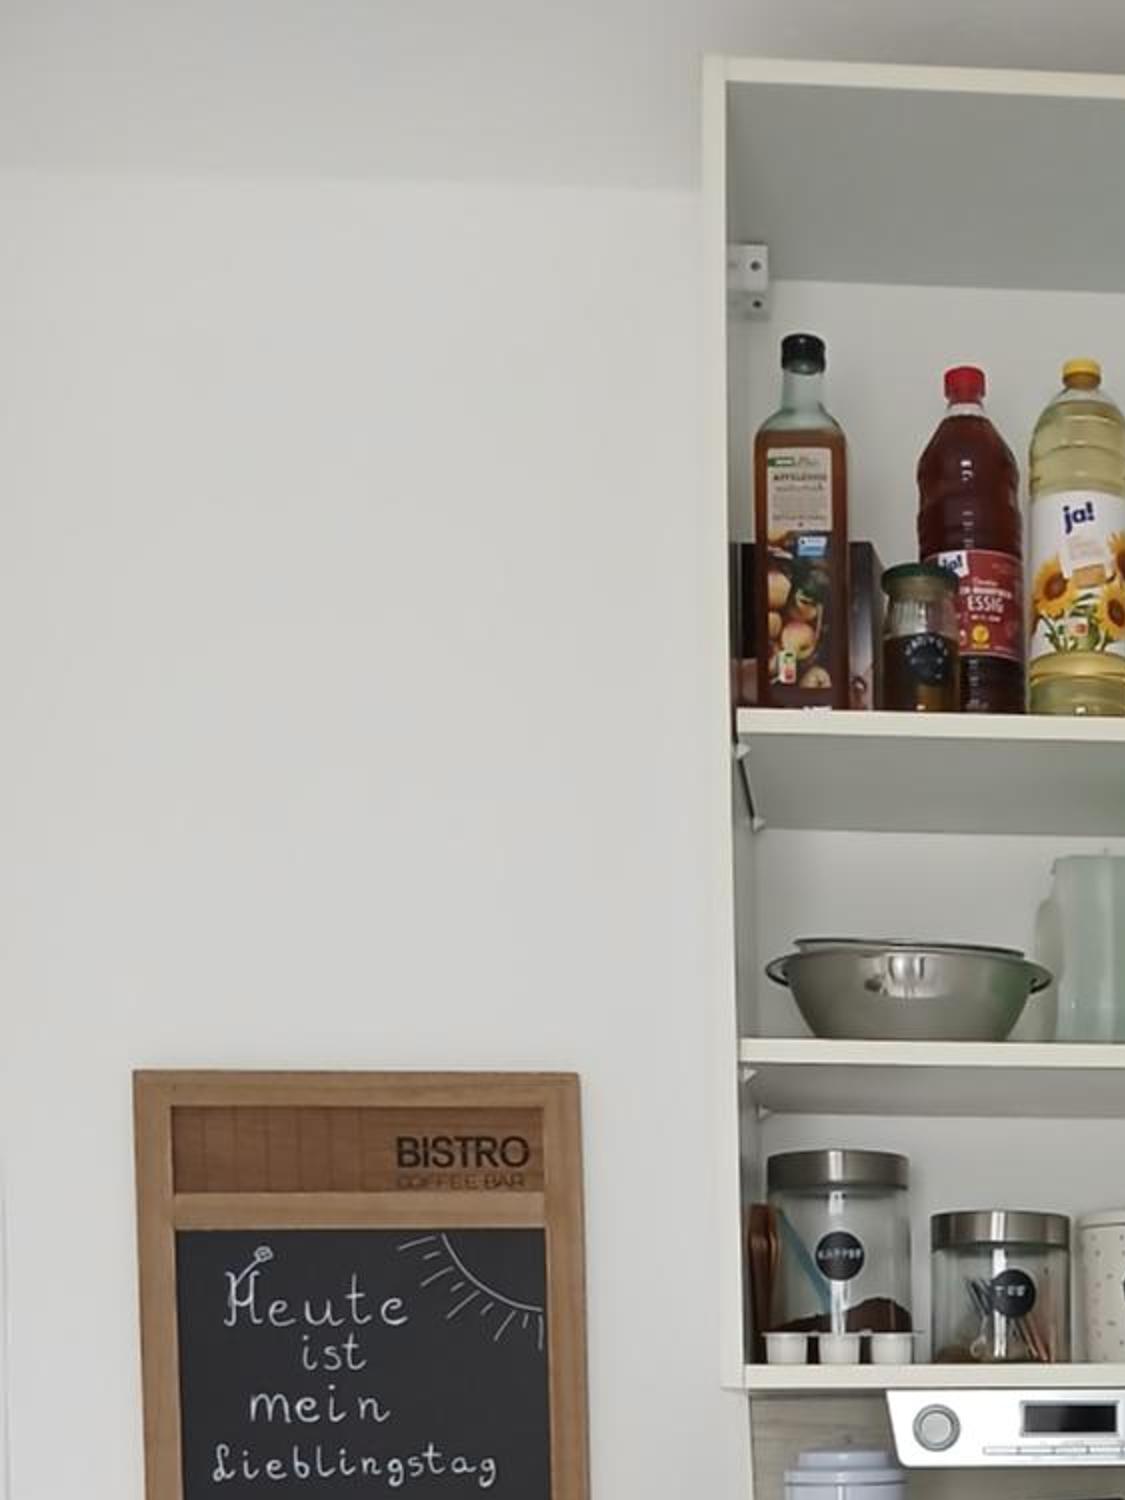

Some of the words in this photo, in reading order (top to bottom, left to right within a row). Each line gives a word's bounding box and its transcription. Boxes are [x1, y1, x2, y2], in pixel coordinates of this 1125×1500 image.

[1062, 501, 1095, 534] ja!
[967, 594, 1004, 614] ESSIG
[396, 1135, 530, 1168] BISTRO
[223, 1270, 408, 1326] Heute
[302, 1333, 367, 1370] ist
[250, 1384, 391, 1423] mein
[212, 1442, 497, 1488] Lieblingstag
